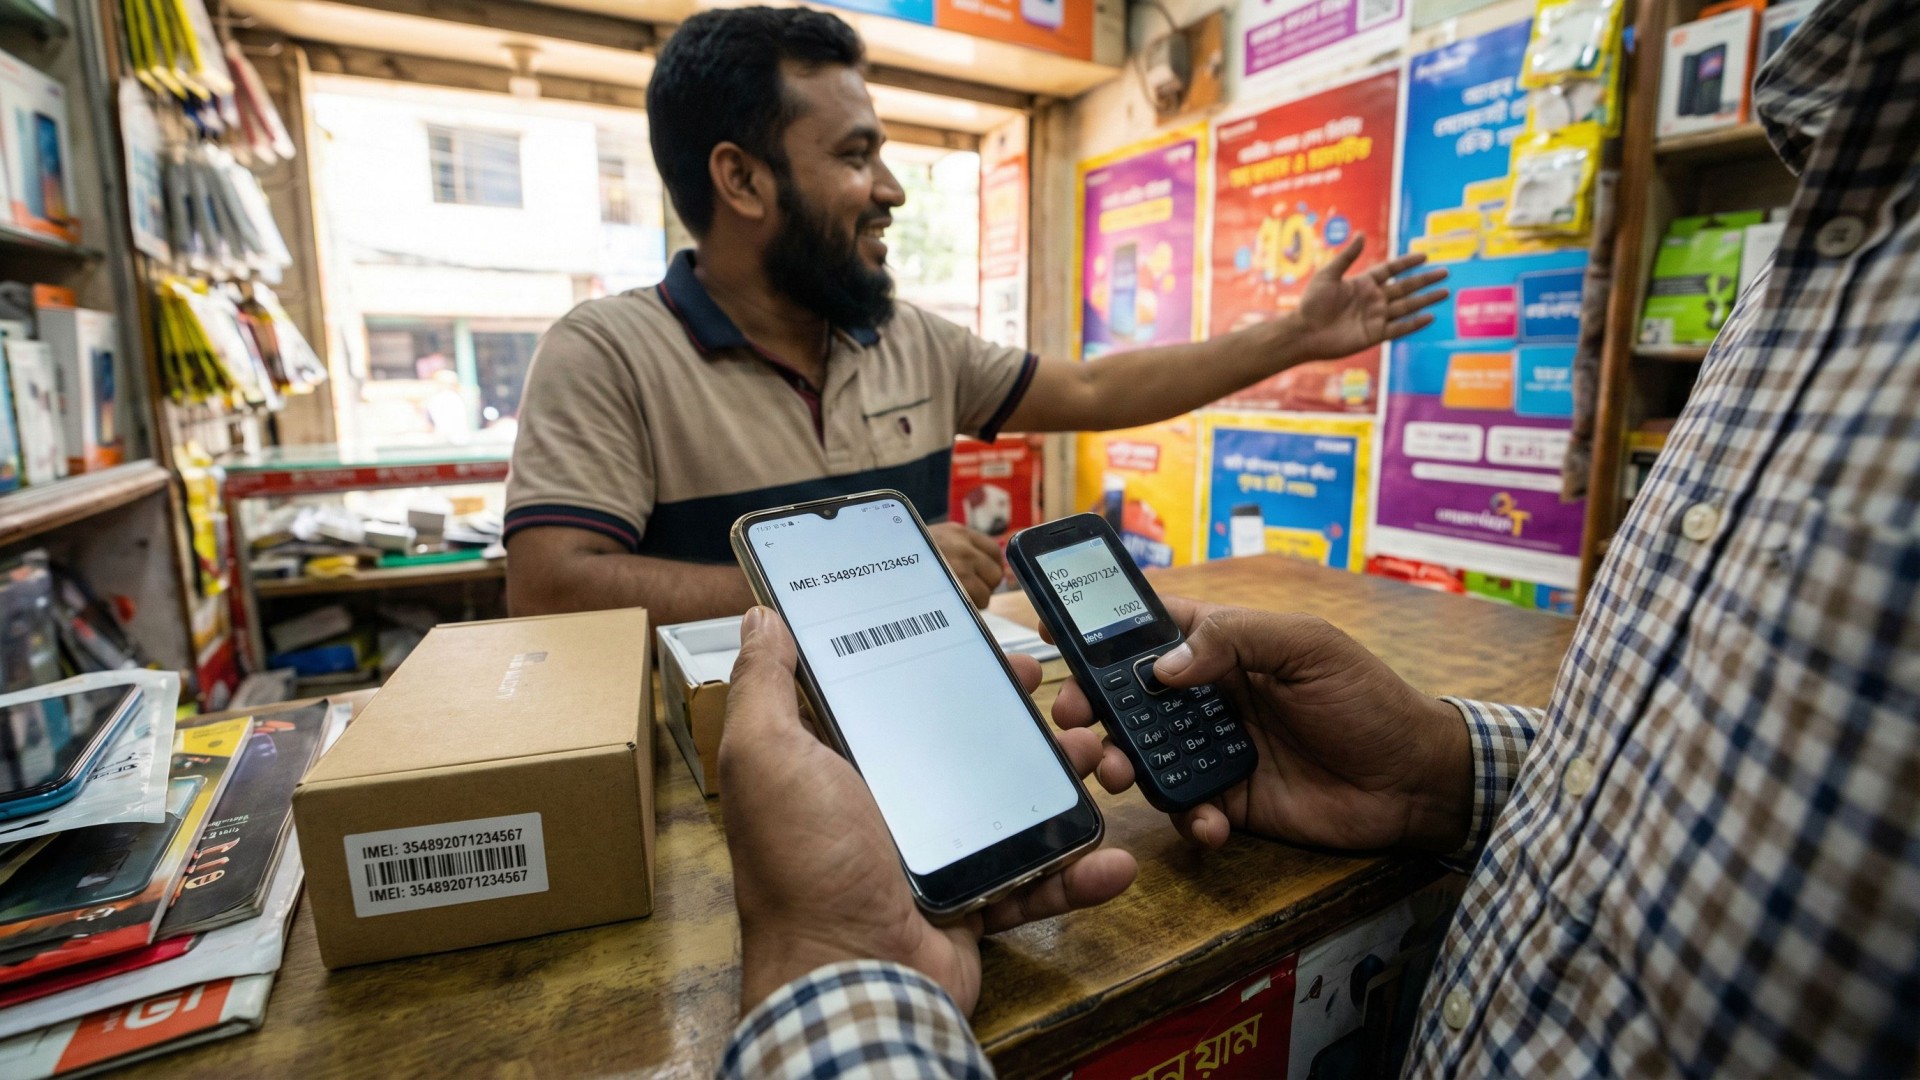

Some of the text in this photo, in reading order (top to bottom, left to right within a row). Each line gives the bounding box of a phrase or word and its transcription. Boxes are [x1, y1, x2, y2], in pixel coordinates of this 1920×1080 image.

[789, 553, 920, 592] IMEI: 354892071234567
[1047, 568, 1069, 582] KYD
[1113, 600, 1142, 617] 16002
[362, 828, 523, 860] IMEI: 354892071234567
[369, 870, 528, 902] IMEI: 354892071234567
